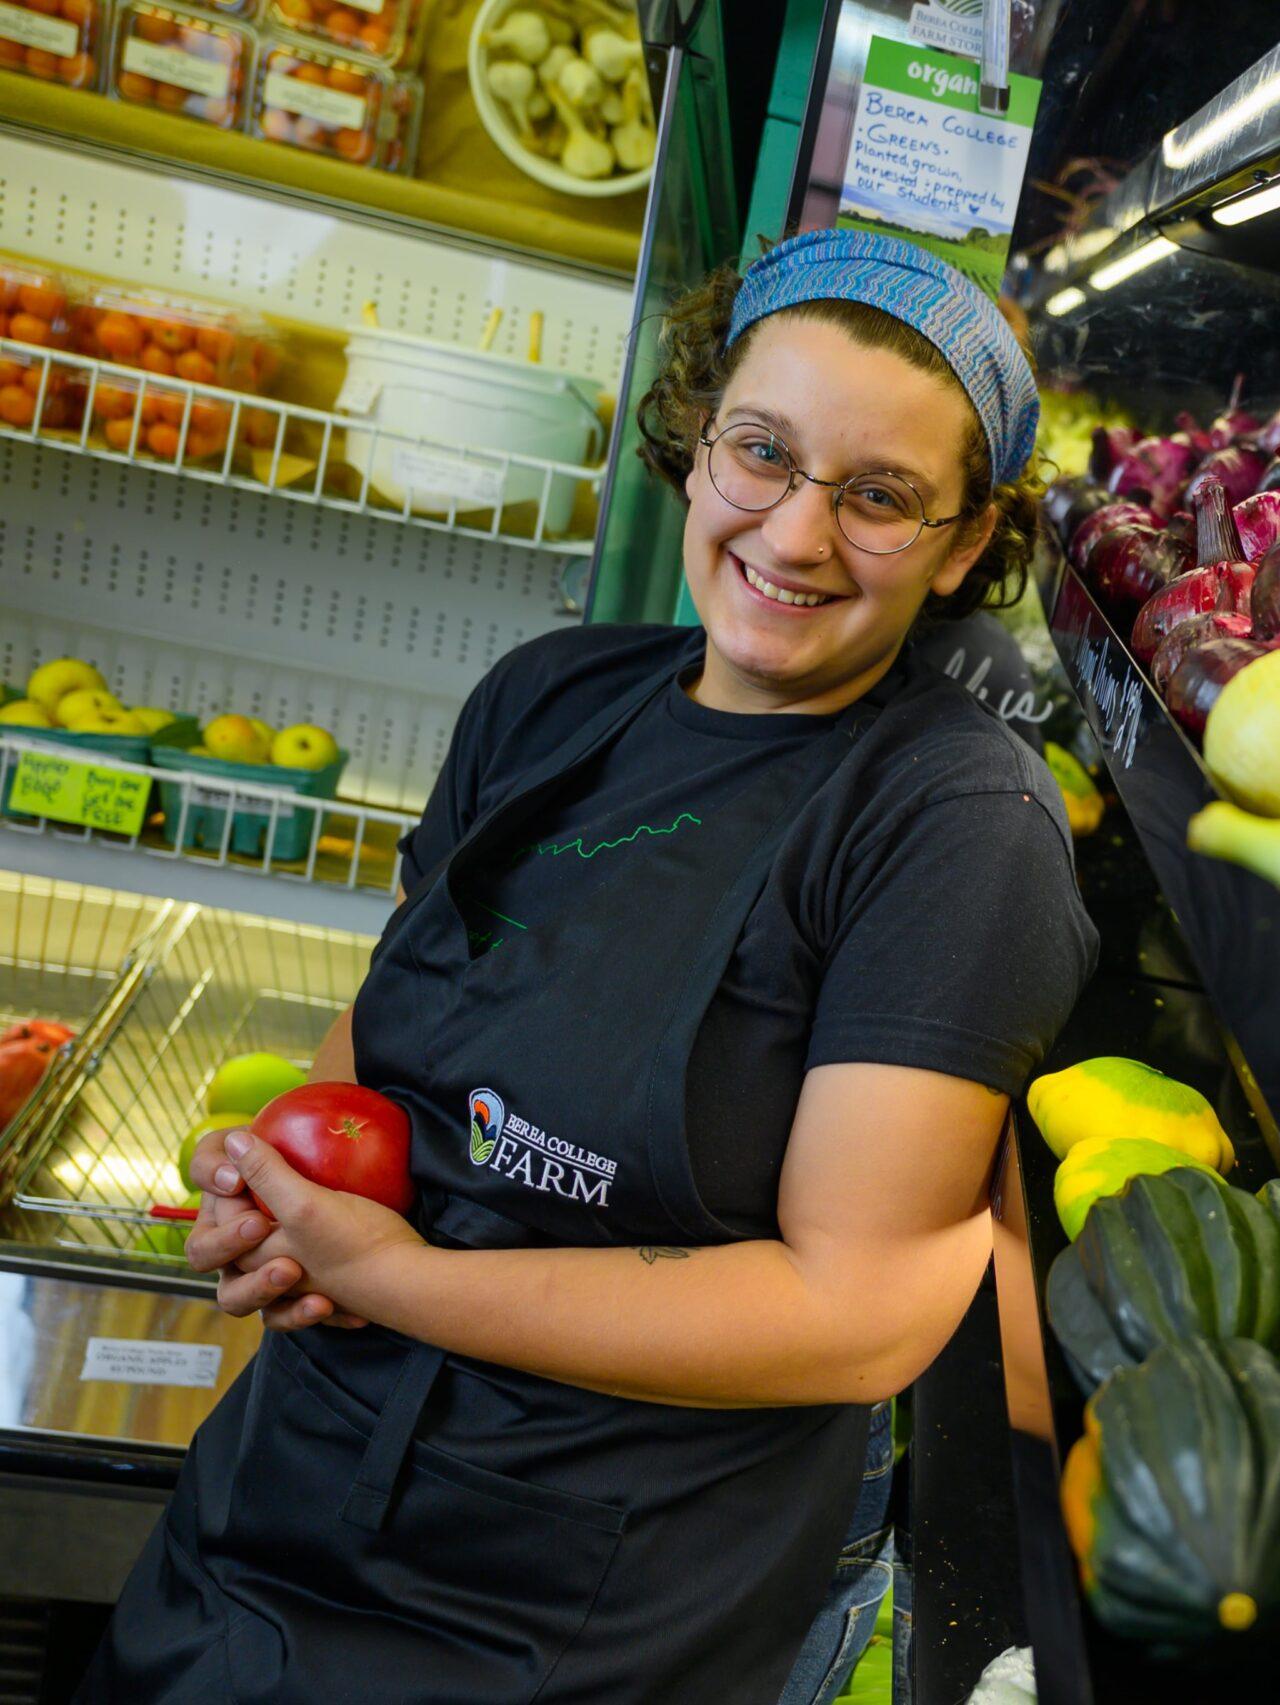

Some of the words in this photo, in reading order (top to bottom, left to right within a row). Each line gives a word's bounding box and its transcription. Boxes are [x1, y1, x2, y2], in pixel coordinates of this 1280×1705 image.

[912, 25, 947, 43] FARM
[949, 37, 983, 52] STOR
[906, 60, 978, 97] organ
[942, 114, 1019, 148] COLLEGE
[857, 176, 886, 192] our
[990, 191, 1005, 213] by
[505, 1113, 546, 1148] BEREA
[547, 1136, 618, 1176] COLLEGE
[489, 1135, 613, 1208] FARM
